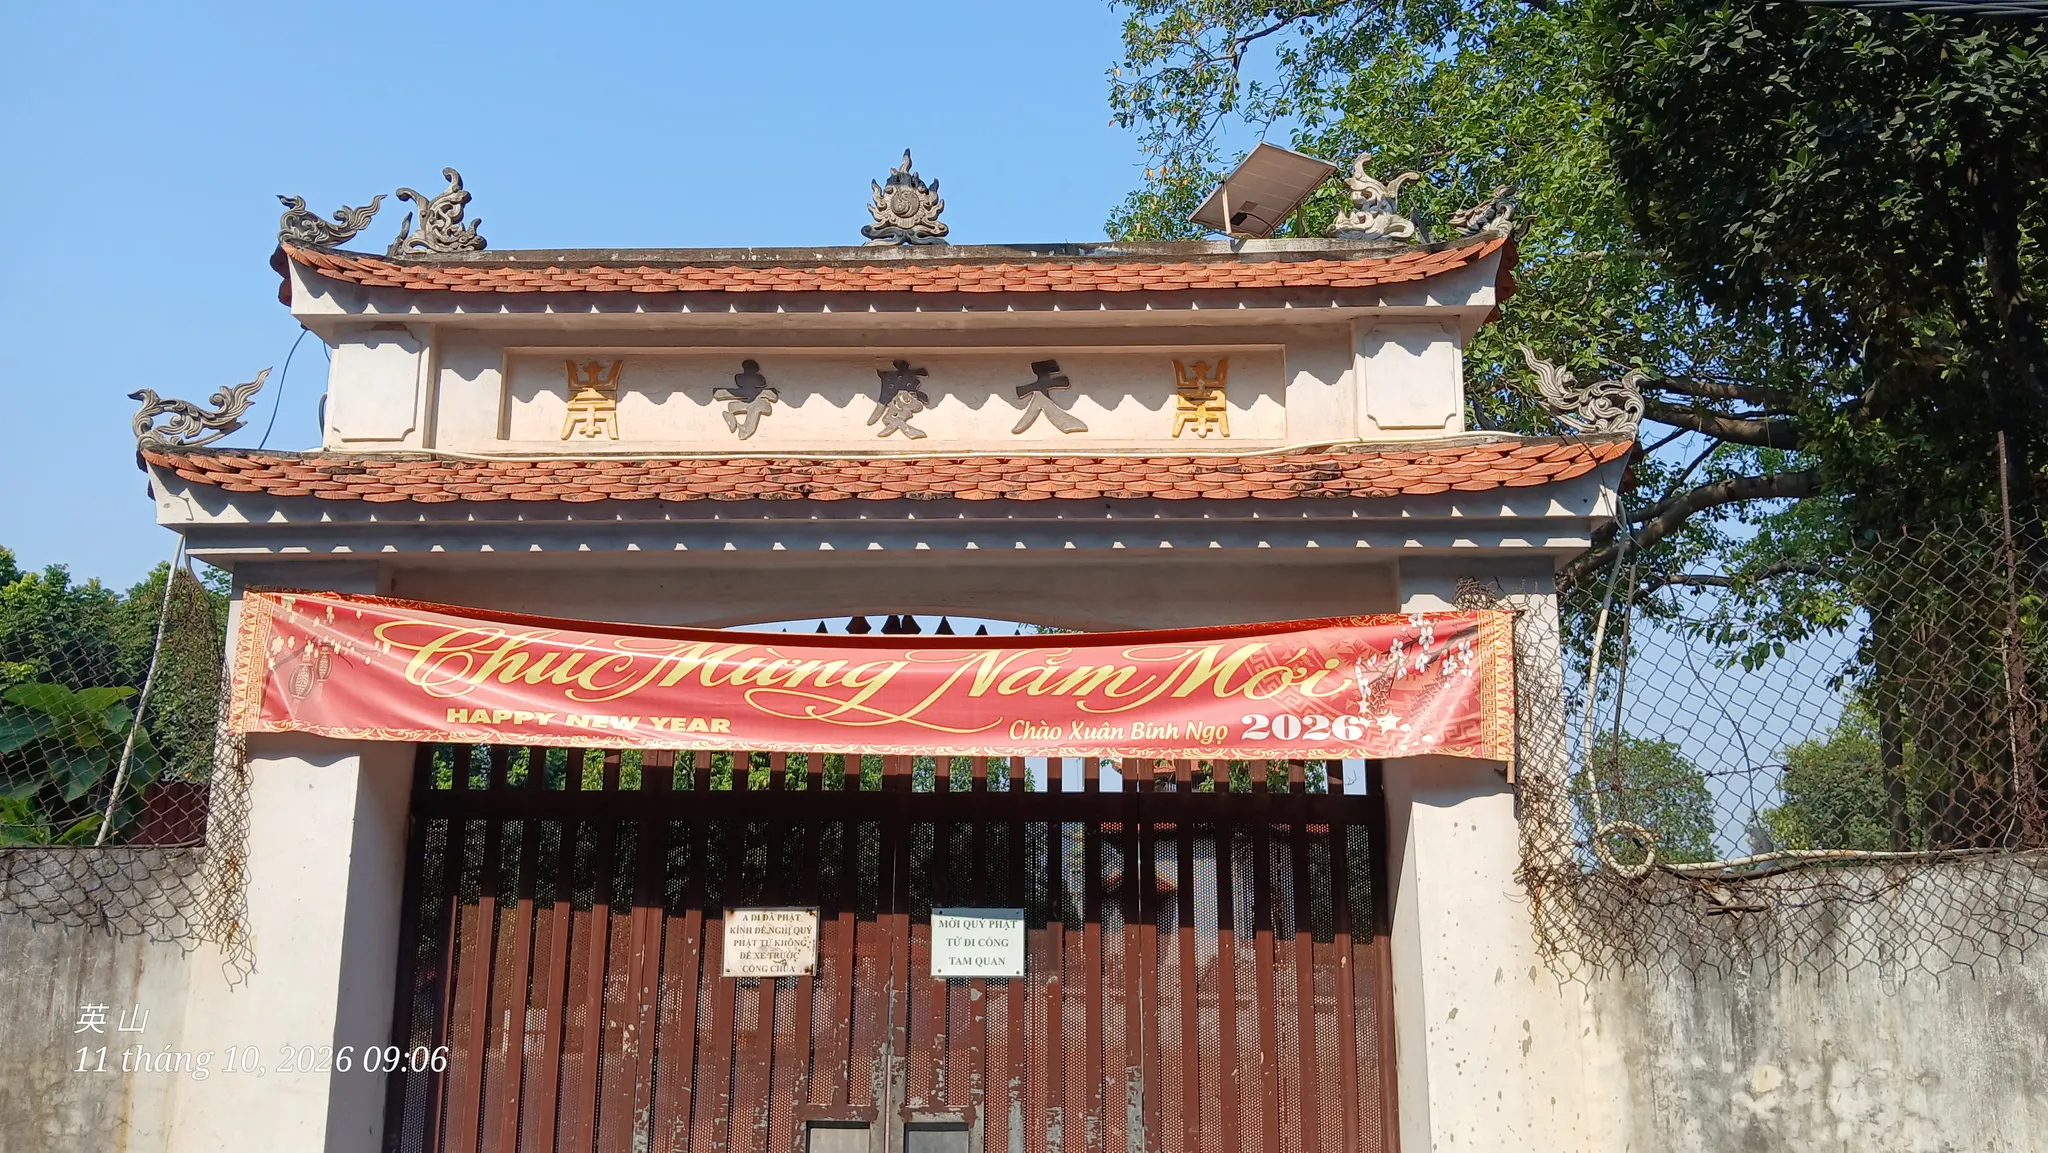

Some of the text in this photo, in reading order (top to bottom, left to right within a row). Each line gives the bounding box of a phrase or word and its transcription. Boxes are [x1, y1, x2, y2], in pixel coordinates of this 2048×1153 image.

[373, 620, 1352, 727] Chúc Mừng Năm Mới
[446, 708, 731, 734] HAPPY NEW YEAR
[1241, 713, 1364, 741] 2026
[1008, 719, 1229, 745] Chào Xuân Bính Ngọ
[777, 913, 801, 922] PHẬT
[938, 917, 1017, 930] MỜI QUÝ PHẬT
[729, 925, 752, 934] KÍNH
[793, 925, 812, 935] QUÝ
[733, 939, 757, 948] PHẬT
[774, 938, 807, 946] KHÔNG
[949, 957, 1006, 967] TAM QUAN
